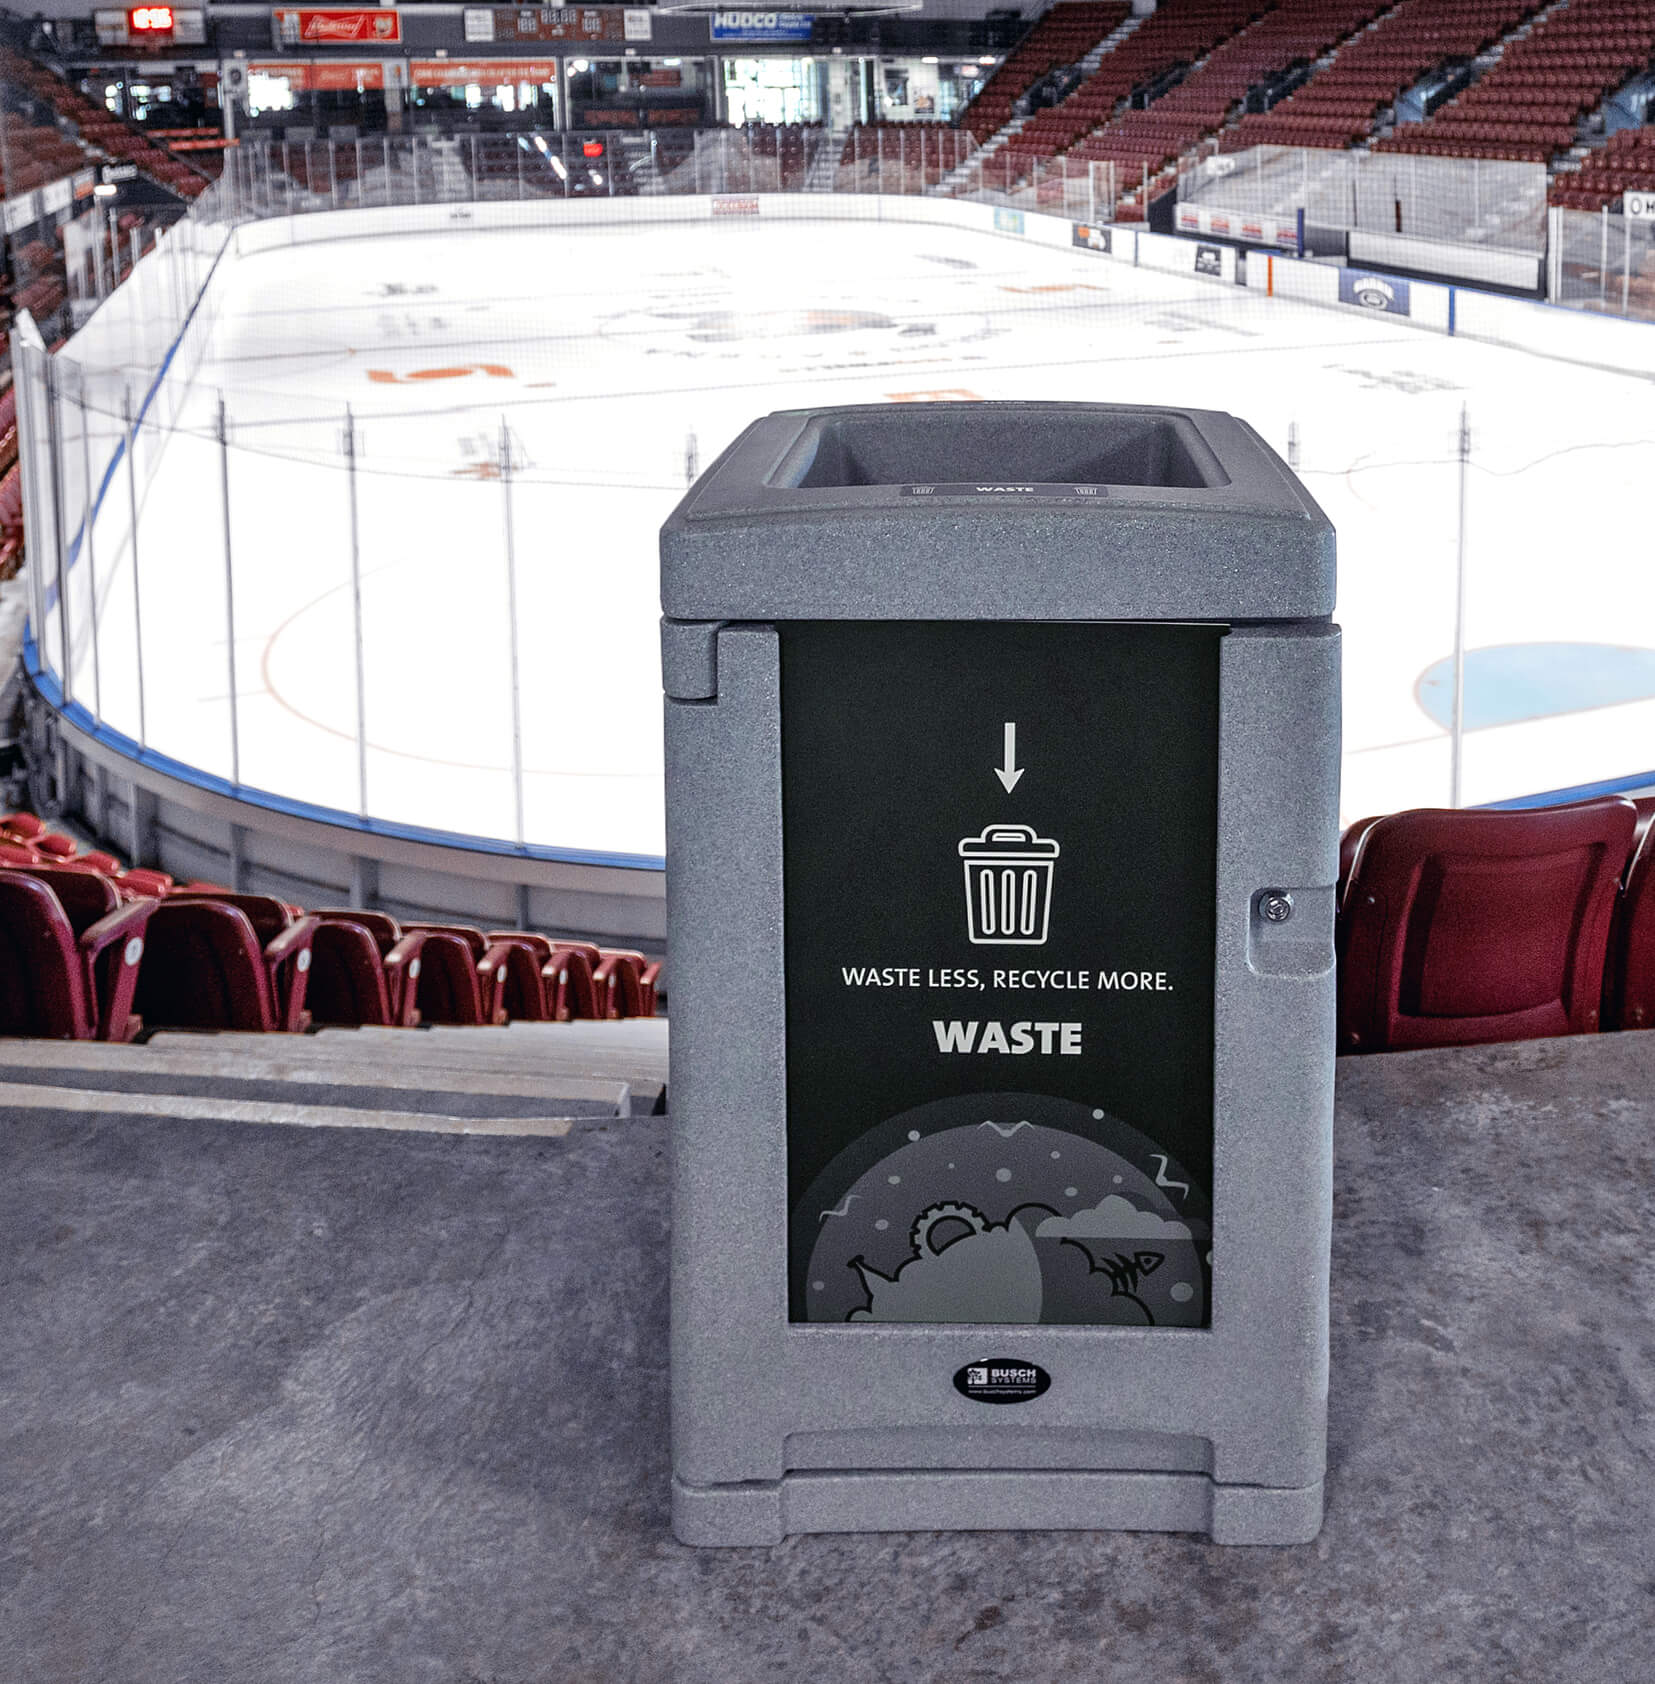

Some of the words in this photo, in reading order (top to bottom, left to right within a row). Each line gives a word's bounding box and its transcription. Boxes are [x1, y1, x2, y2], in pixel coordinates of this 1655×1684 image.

[842, 967, 921, 987] WASTE
[928, 969, 986, 991] LESS,
[993, 969, 1090, 989] RECYCLE
[1097, 970, 1174, 991] MORE.
[932, 1020, 1083, 1055] WASTE
[992, 1369, 1037, 1378] BUSCH
